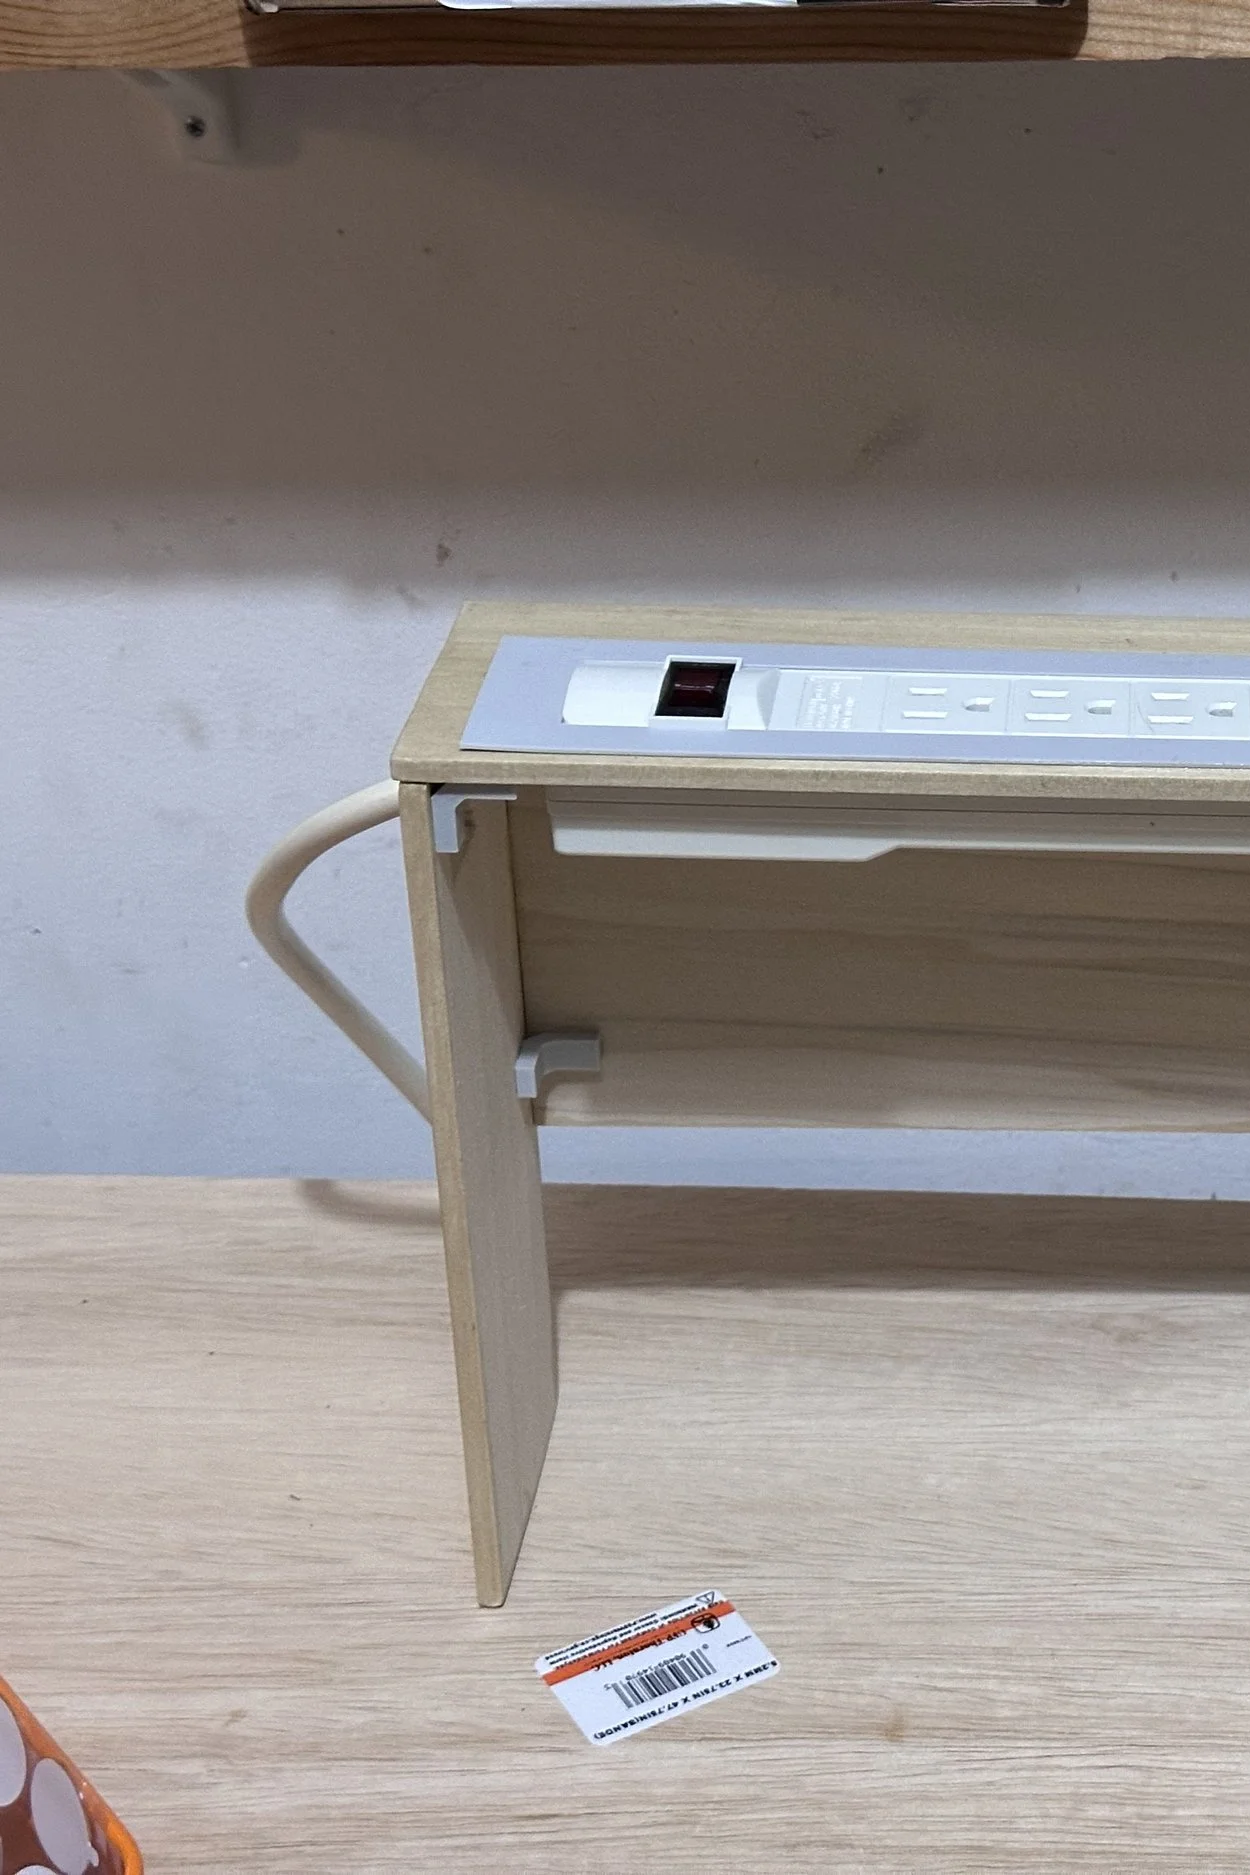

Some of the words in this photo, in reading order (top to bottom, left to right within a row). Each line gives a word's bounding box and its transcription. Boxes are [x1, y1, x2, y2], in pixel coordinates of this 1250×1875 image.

[744, 1660, 777, 1677] 5.2MM
[733, 1673, 743, 1681] X
[680, 1696, 690, 1704] X
